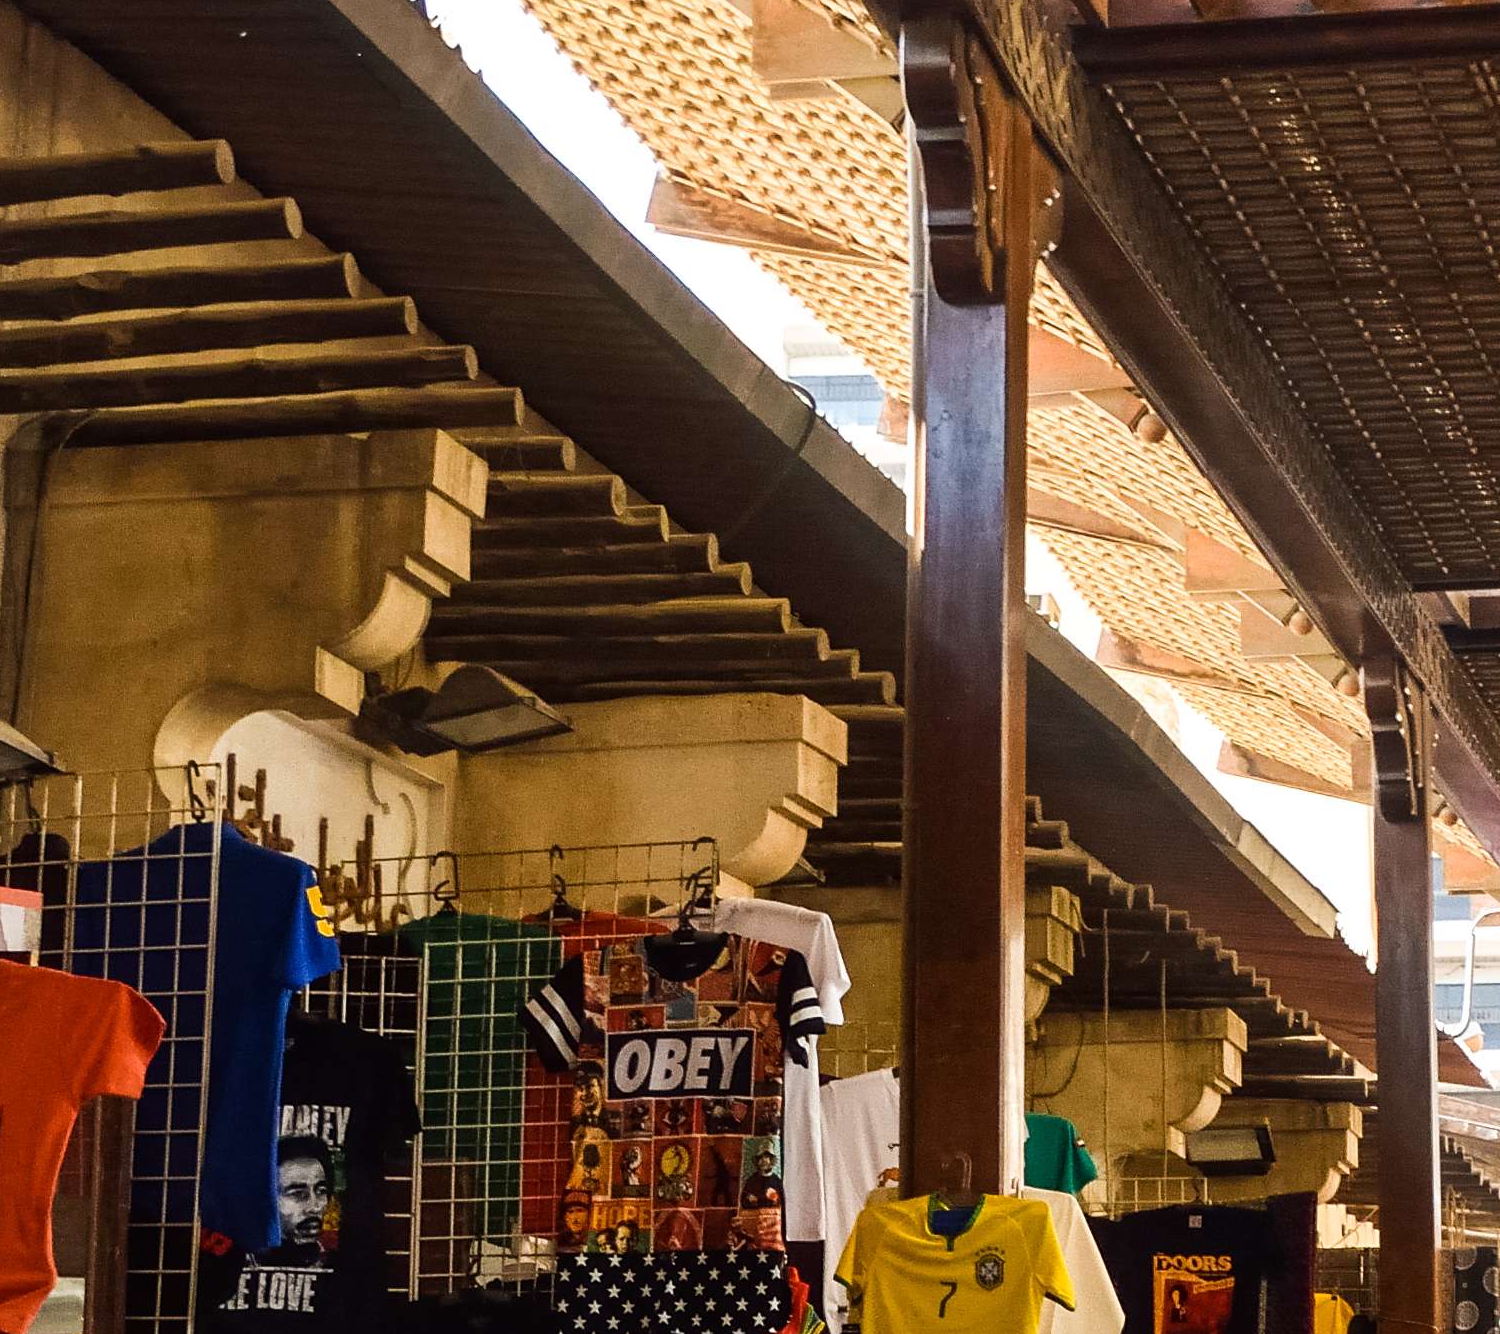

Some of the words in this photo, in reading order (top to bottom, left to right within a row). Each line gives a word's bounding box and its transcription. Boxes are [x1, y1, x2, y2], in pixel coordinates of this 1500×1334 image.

[613, 1036, 750, 1094] OBEY
[1153, 1254, 1233, 1273] DOORS
[255, 1271, 318, 1314] LOVE
[938, 1280, 958, 1319] 7
